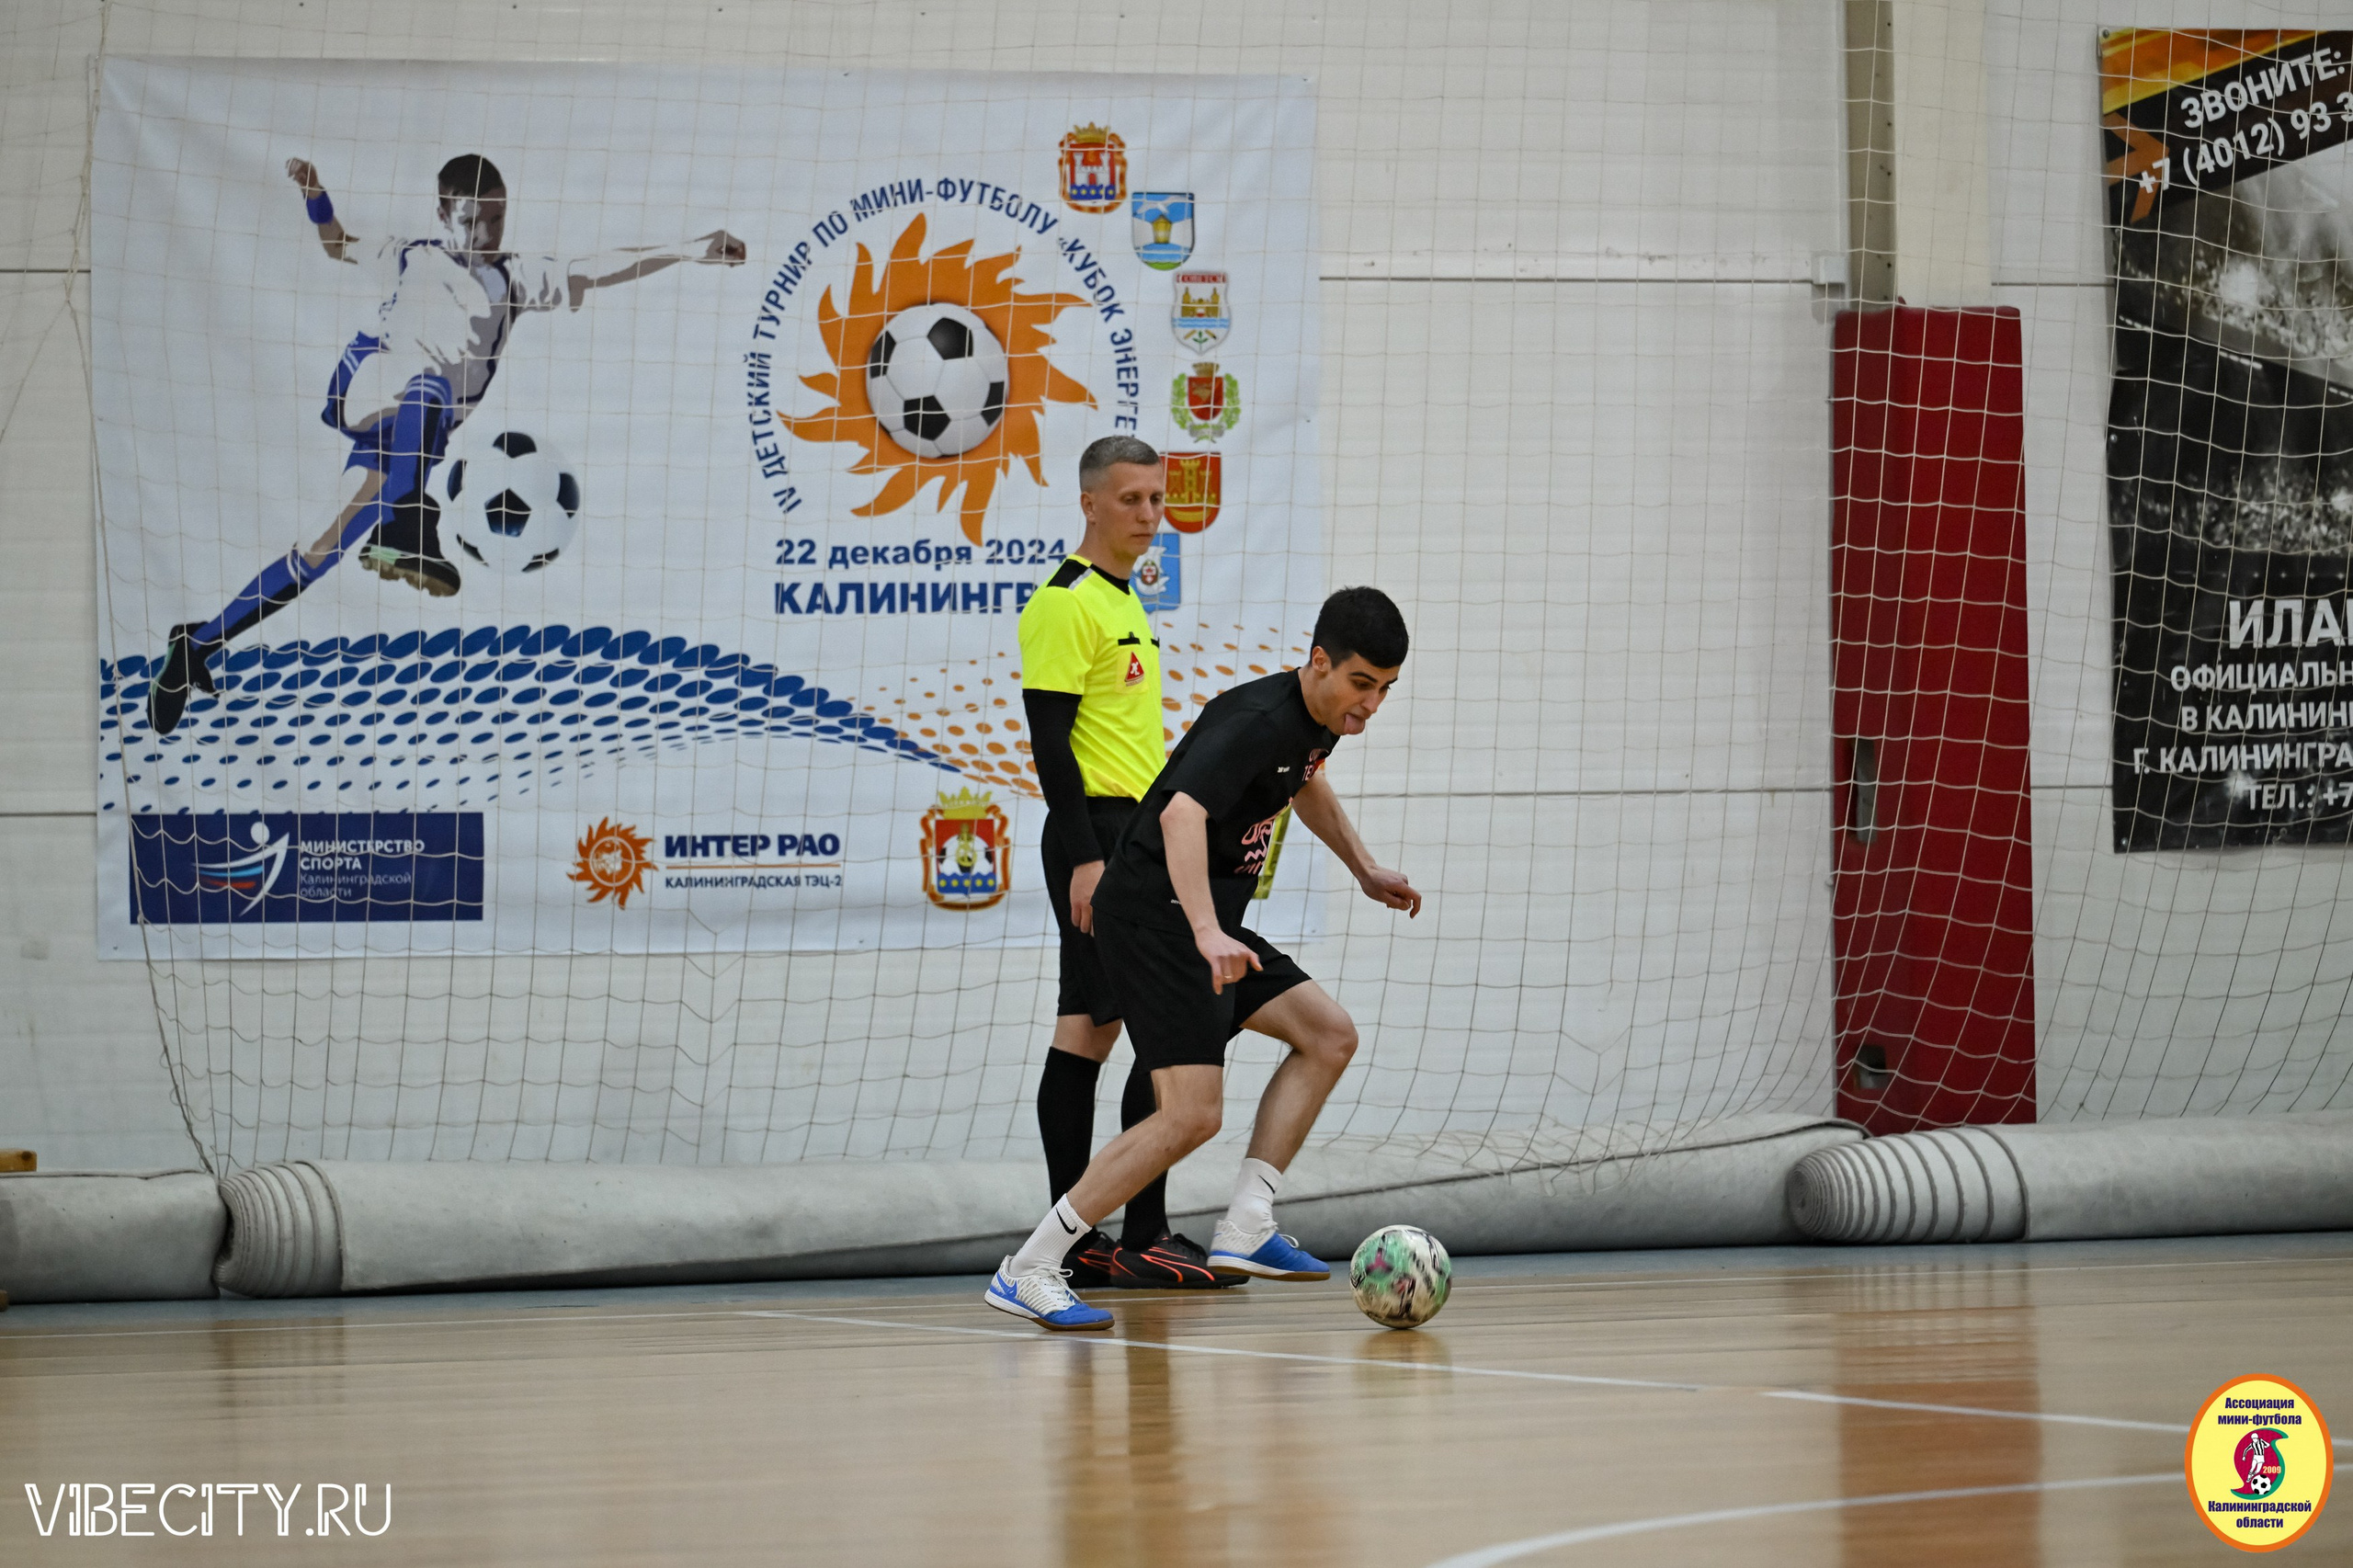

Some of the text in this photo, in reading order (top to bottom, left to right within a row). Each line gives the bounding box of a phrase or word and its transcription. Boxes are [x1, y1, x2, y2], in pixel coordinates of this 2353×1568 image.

[2180, 47, 2345, 129] ЗВОНИТЕ:
[2139, 157, 2170, 194] +7
[2183, 117, 2285, 187] (4012)
[2290, 101, 2332, 140] 93
[744, 177, 1139, 515] IV ДЕТСКИЙ ТУРНИР ПО МИНИ-ФУТБОЛУ «КУБОК ЭНЕРГЕ
[776, 539, 1068, 572] 22 декабря 2024
[2181, 706, 2198, 732] В
[2133, 747, 2150, 774] Г.
[301, 840, 425, 854] МИНИСТЕРСТВО
[665, 834, 840, 858] ИНТЕР РАО
[300, 857, 362, 871] СПОРТА
[301, 872, 412, 886] Калининградской
[665, 874, 842, 890] КАЛИНИНГРАДСКАЯ ТЭЦ-2
[300, 887, 352, 899] области
